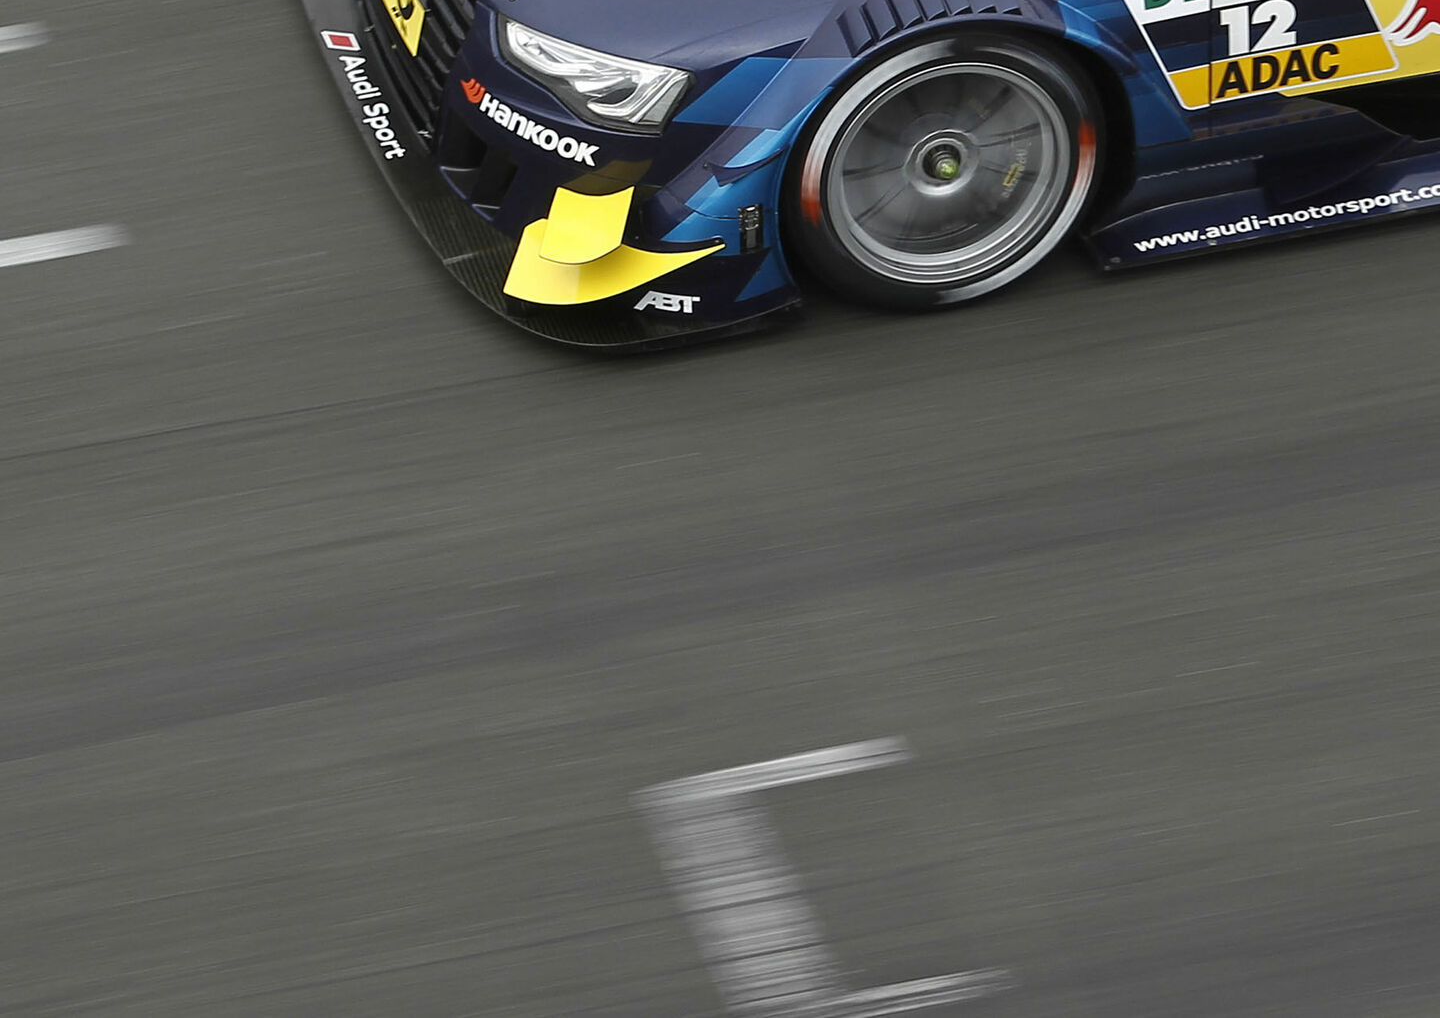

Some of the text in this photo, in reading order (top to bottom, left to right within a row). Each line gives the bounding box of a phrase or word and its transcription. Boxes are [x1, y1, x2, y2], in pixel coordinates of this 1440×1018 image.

[1216, 43, 1339, 98] ADAC
[338, 55, 406, 160] Audi Sport
[633, 290, 701, 314] ABT
